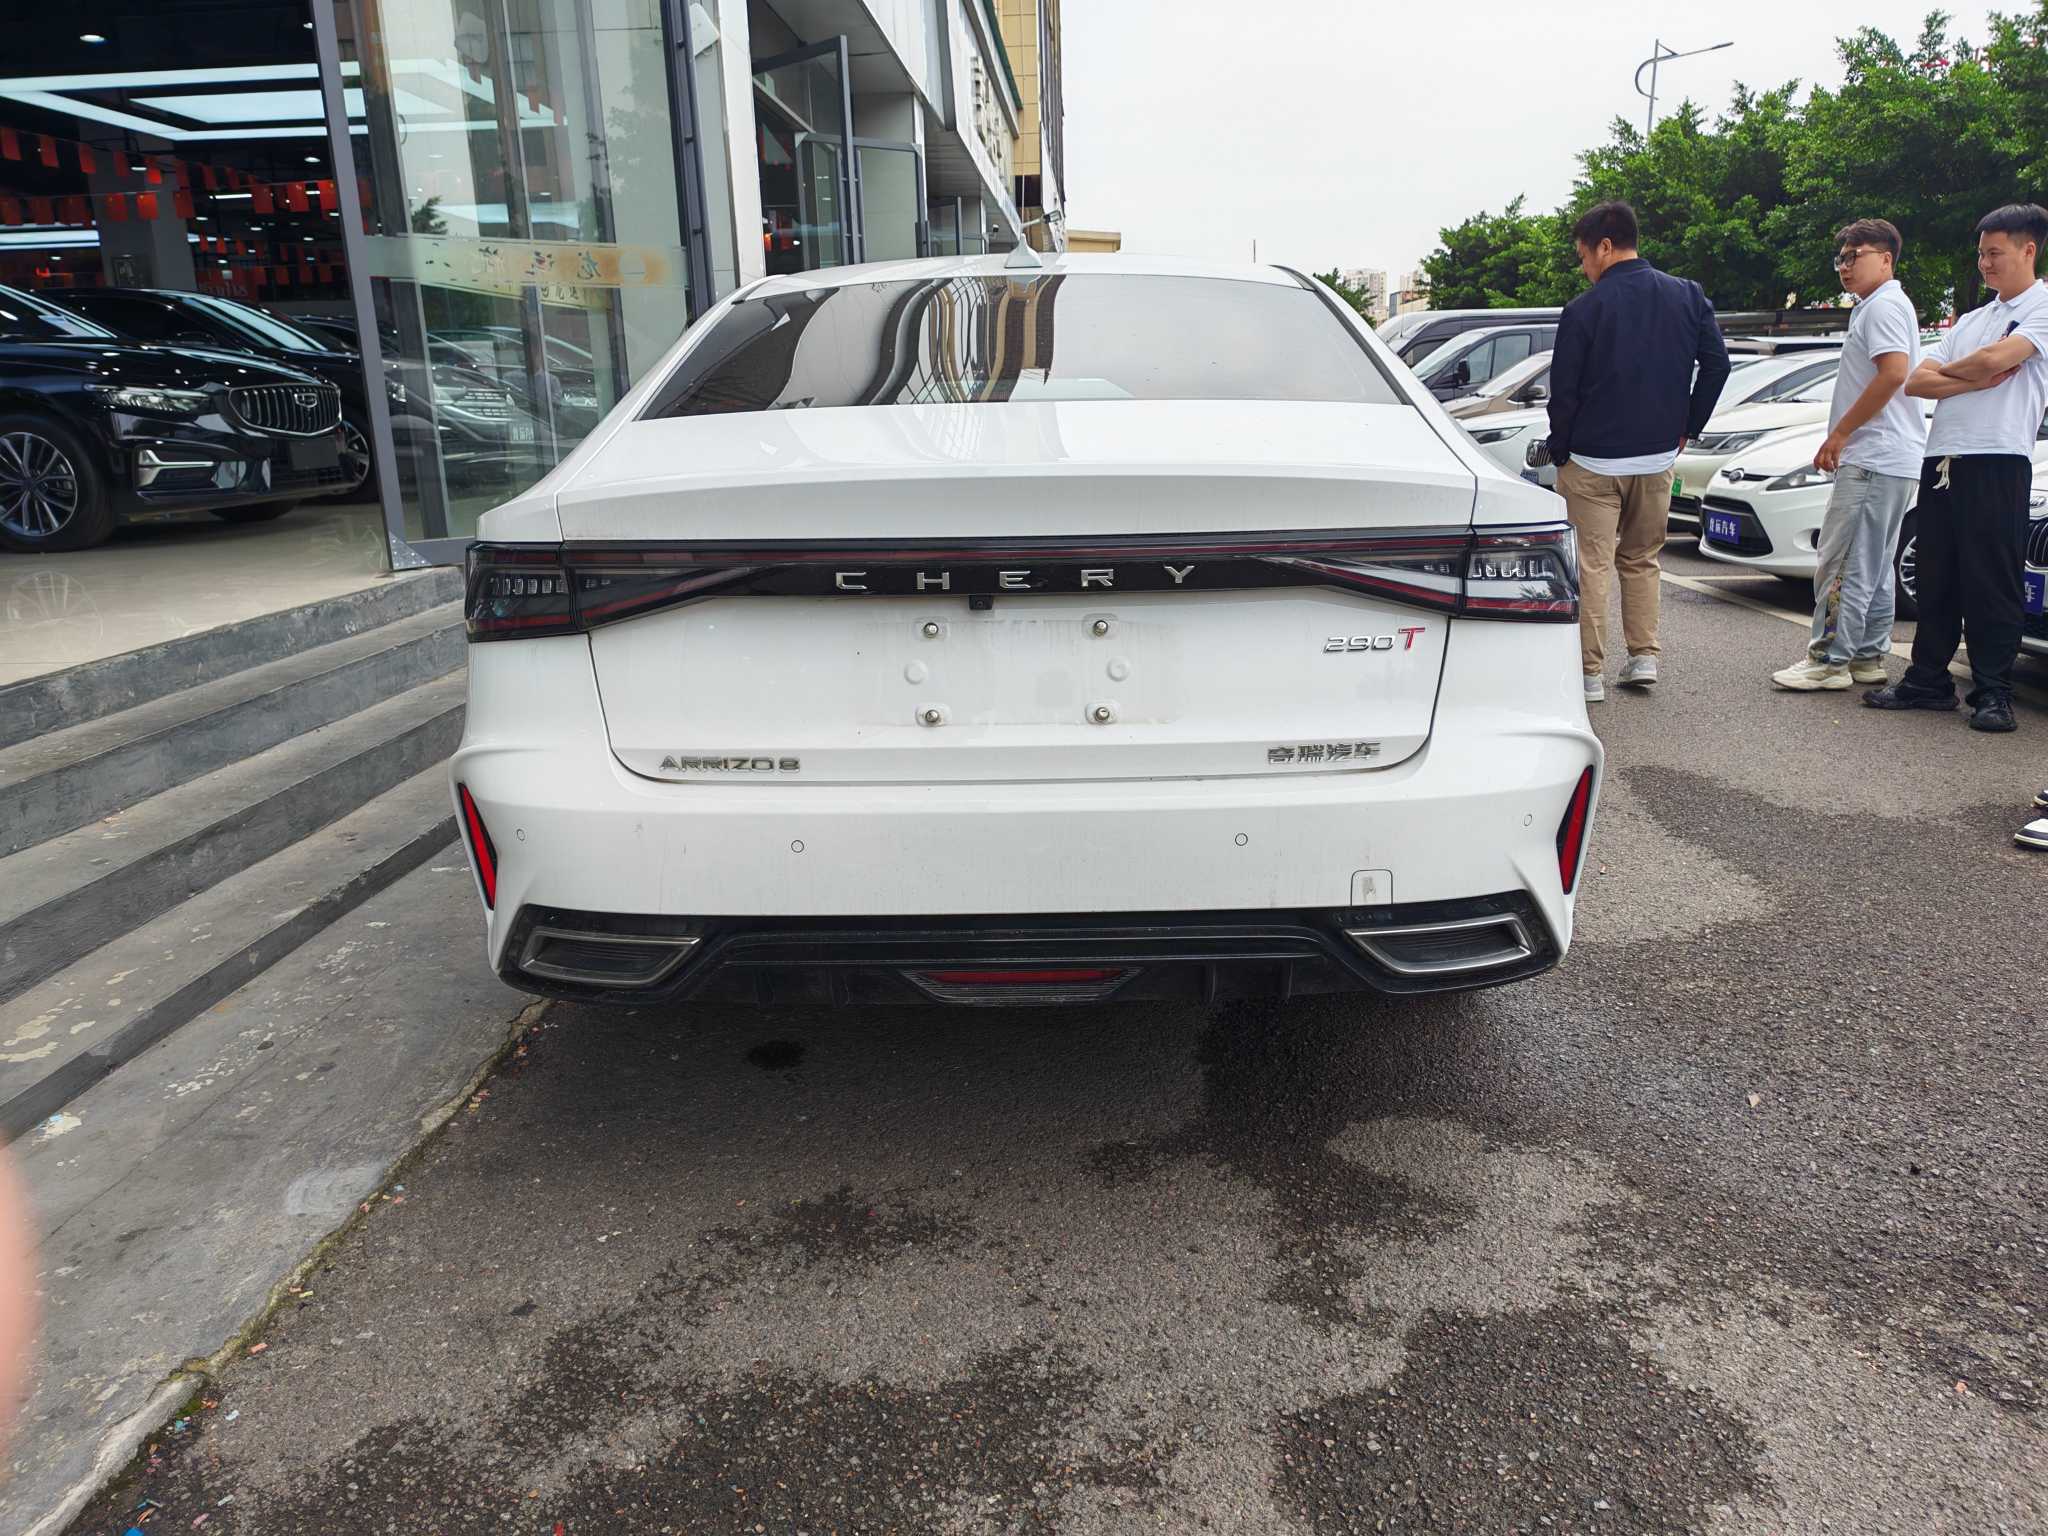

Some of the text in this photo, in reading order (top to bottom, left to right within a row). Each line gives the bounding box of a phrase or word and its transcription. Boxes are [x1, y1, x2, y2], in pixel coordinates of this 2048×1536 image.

[835, 565, 1195, 590] CHERY
[1322, 627, 1426, 653] 290T
[660, 755, 774, 772] ARRIZO
[1267, 742, 1381, 763] 奇瑞汽车
